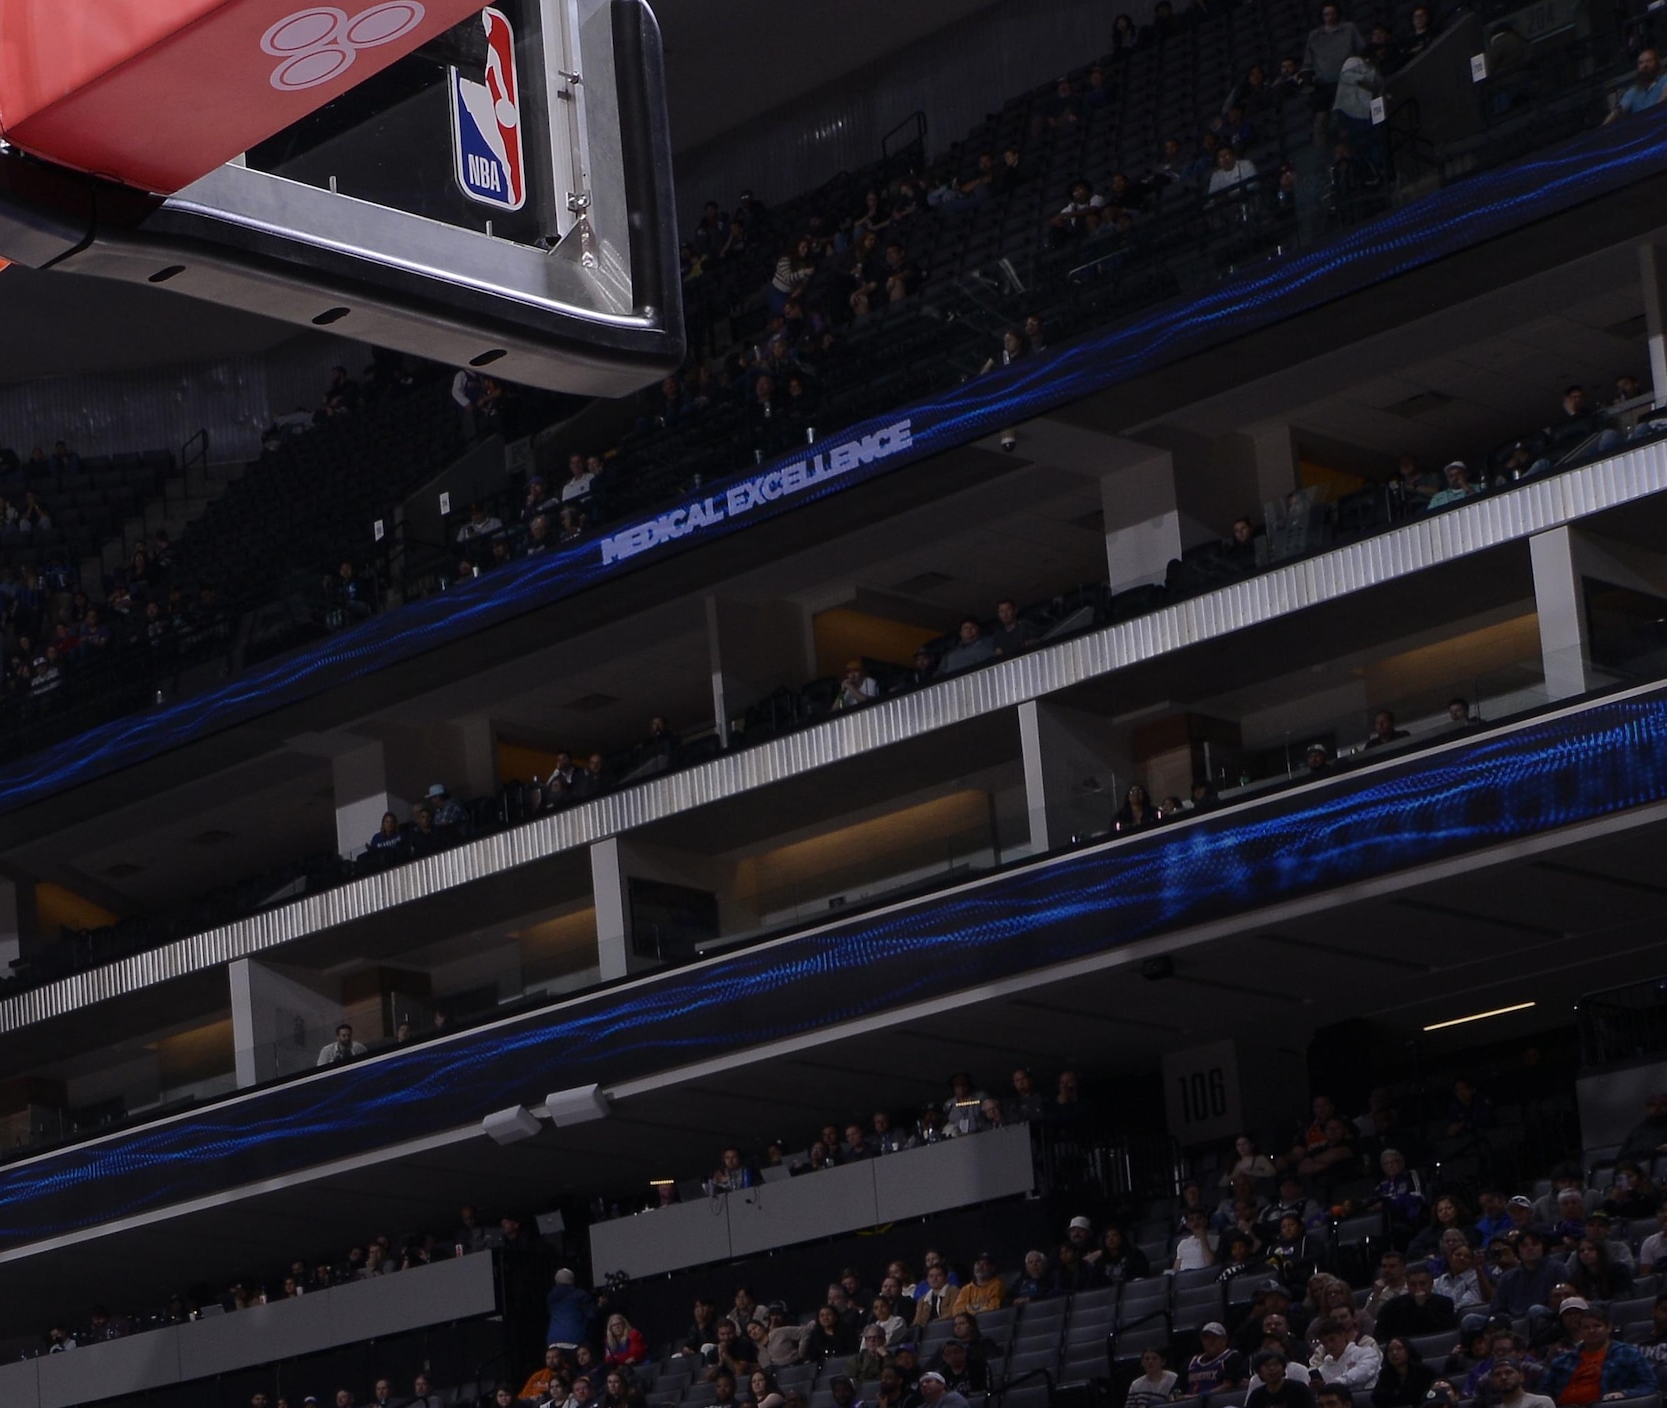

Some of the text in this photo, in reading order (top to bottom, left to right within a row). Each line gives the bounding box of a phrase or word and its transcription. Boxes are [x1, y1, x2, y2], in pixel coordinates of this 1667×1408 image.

[468, 154, 501, 192] NBA
[600, 419, 913, 565] MEDICAL EXCELLENCE
[1178, 1068, 1227, 1124] 106
